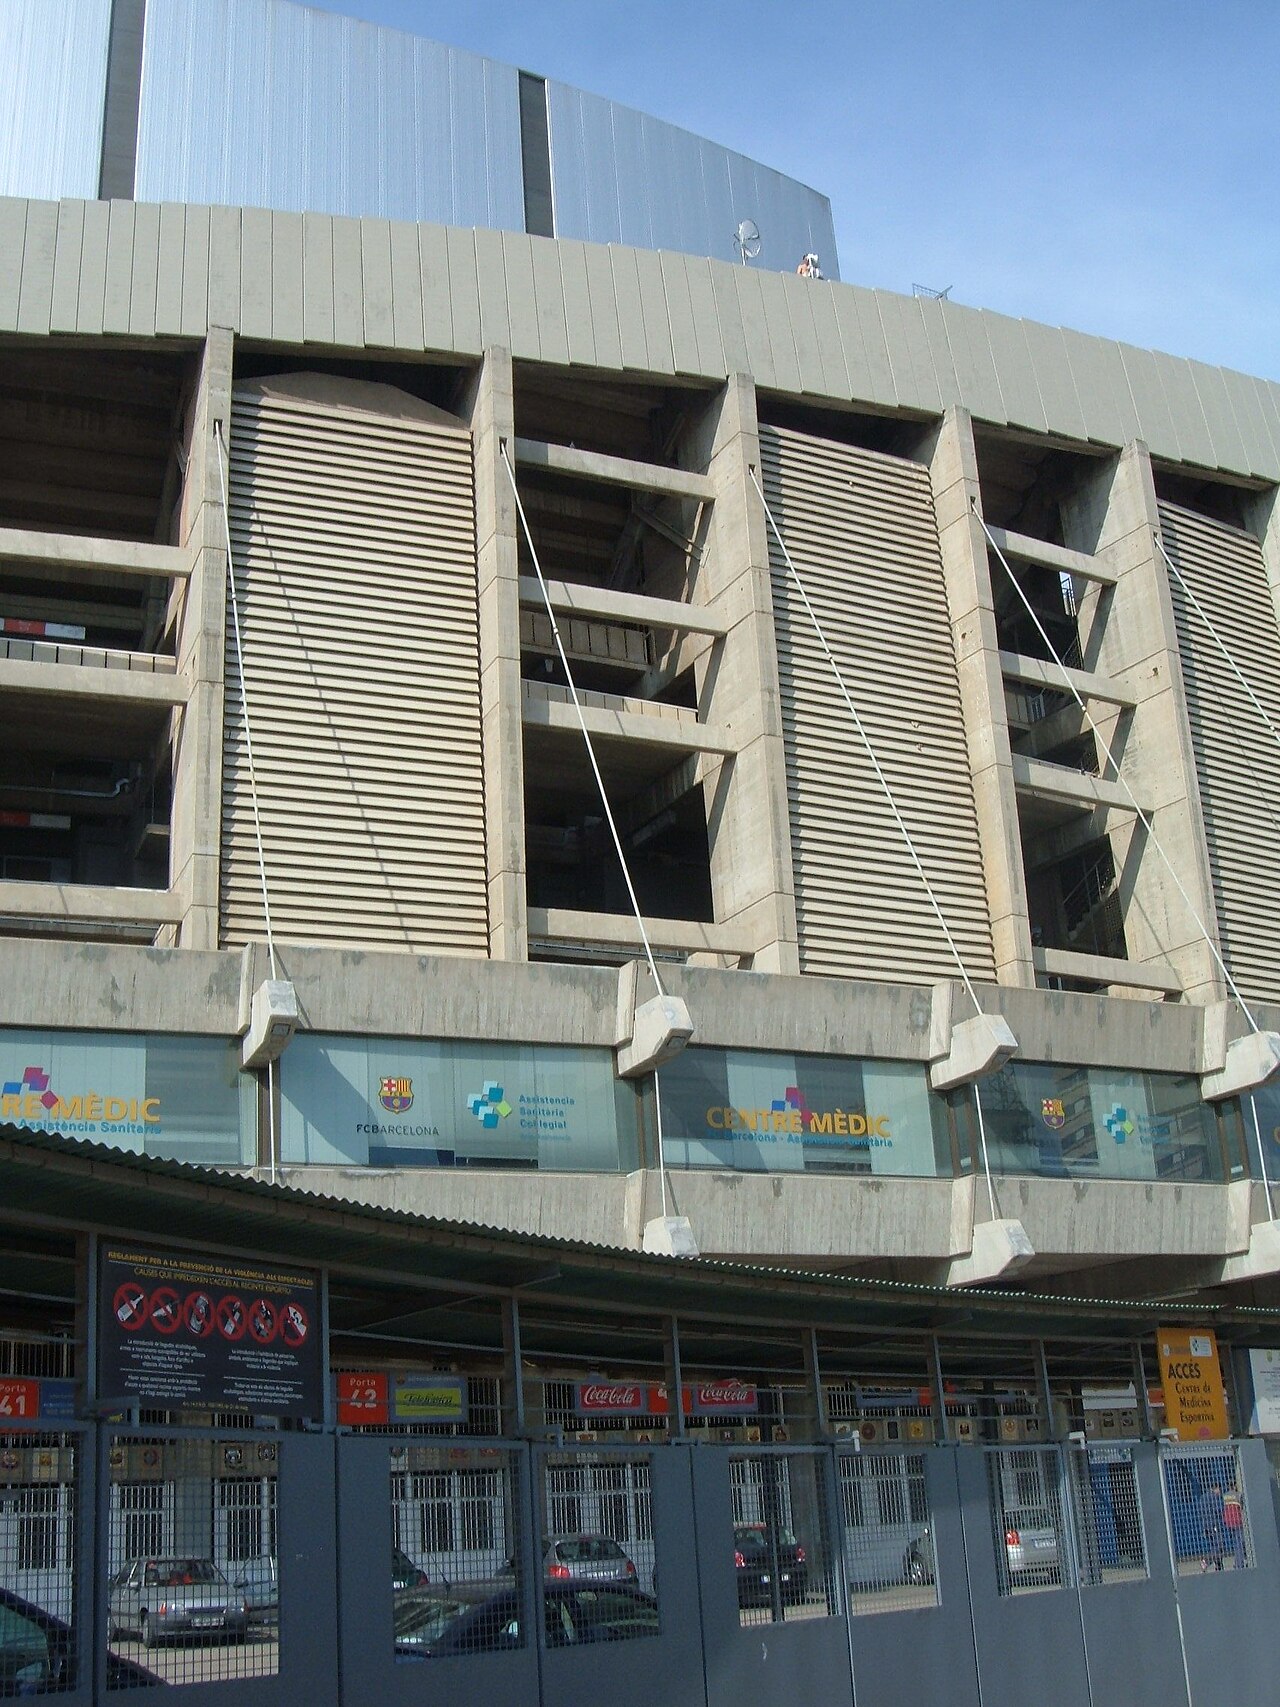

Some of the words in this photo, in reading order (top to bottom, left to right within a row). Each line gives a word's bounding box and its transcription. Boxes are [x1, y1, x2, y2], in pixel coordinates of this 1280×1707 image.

[51, 1088, 161, 1122] MÈDIC
[706, 1107, 803, 1133] CENTRE
[811, 1108, 891, 1138] MÈDIC
[350, 1377, 376, 1387] Porta
[0, 1395, 26, 1415] 41
[350, 1389, 377, 1408] 42
[583, 1385, 635, 1405] Coca-Cola
